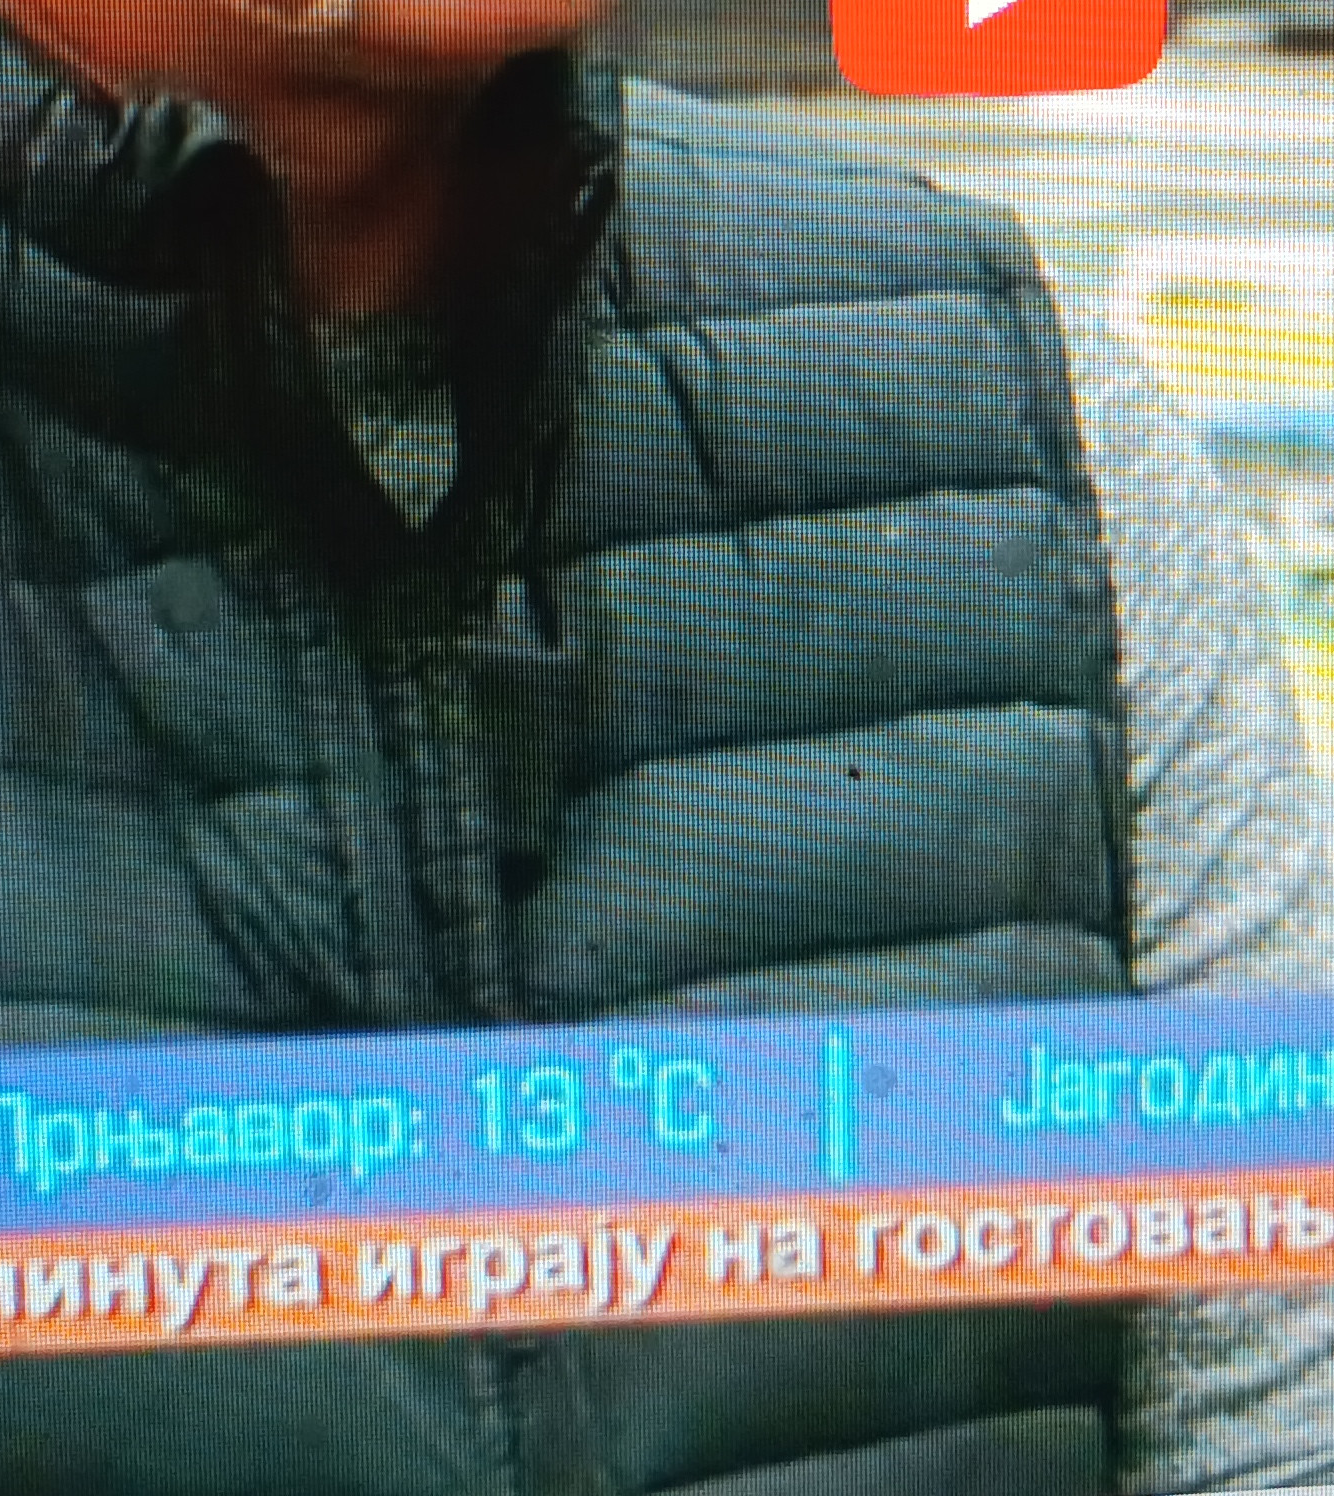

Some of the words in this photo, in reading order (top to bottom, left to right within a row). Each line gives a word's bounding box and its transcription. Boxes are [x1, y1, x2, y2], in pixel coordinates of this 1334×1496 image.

[473, 1062, 585, 1157] 13
[354, 1213, 680, 1316] играју
[703, 1218, 823, 1284] на
